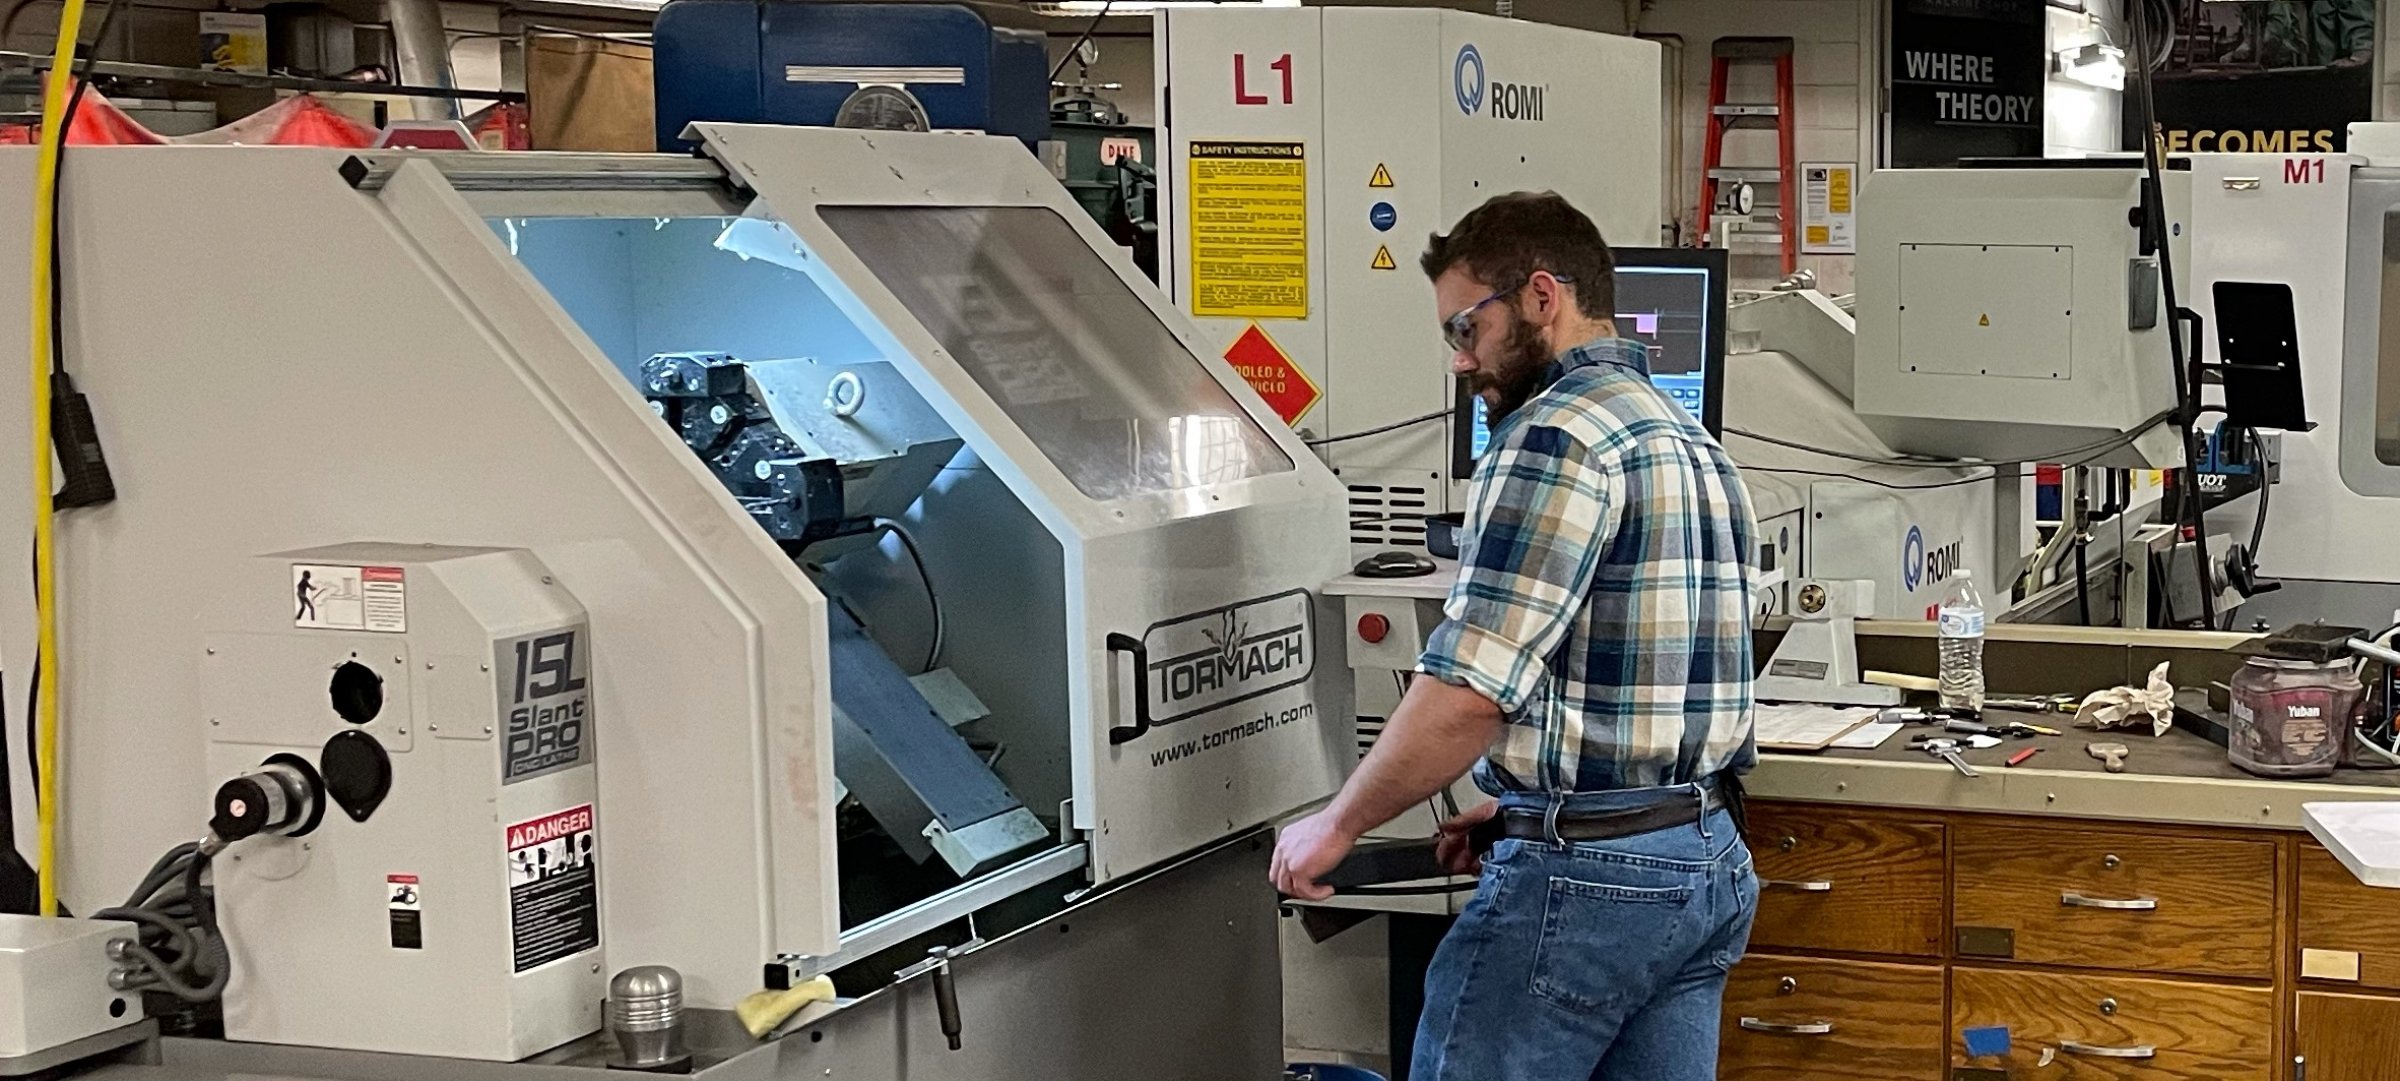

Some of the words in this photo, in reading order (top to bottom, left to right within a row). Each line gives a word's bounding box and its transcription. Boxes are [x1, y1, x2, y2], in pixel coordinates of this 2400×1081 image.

[1234, 53, 1292, 105] L1
[1905, 50, 1994, 83] WHERE
[1491, 81, 1543, 121] ROMI
[1935, 91, 2034, 123] THEORY
[1201, 145, 1232, 155] SAFETY
[1233, 146, 1292, 155] INSTRUCTIONS
[2168, 129, 2334, 153] ECOMES
[2284, 158, 2325, 184] M1
[1277, 366, 1286, 379] &
[1926, 540, 1960, 587] ROMI
[514, 630, 586, 704] 15L
[1149, 630, 1304, 704] TORMACH
[509, 698, 585, 733] Slant
[2287, 705, 2321, 718] Yuban
[505, 719, 582, 779] PRO
[1150, 703, 1314, 768] www.tormach.com
[525, 811, 591, 845] DANGER
